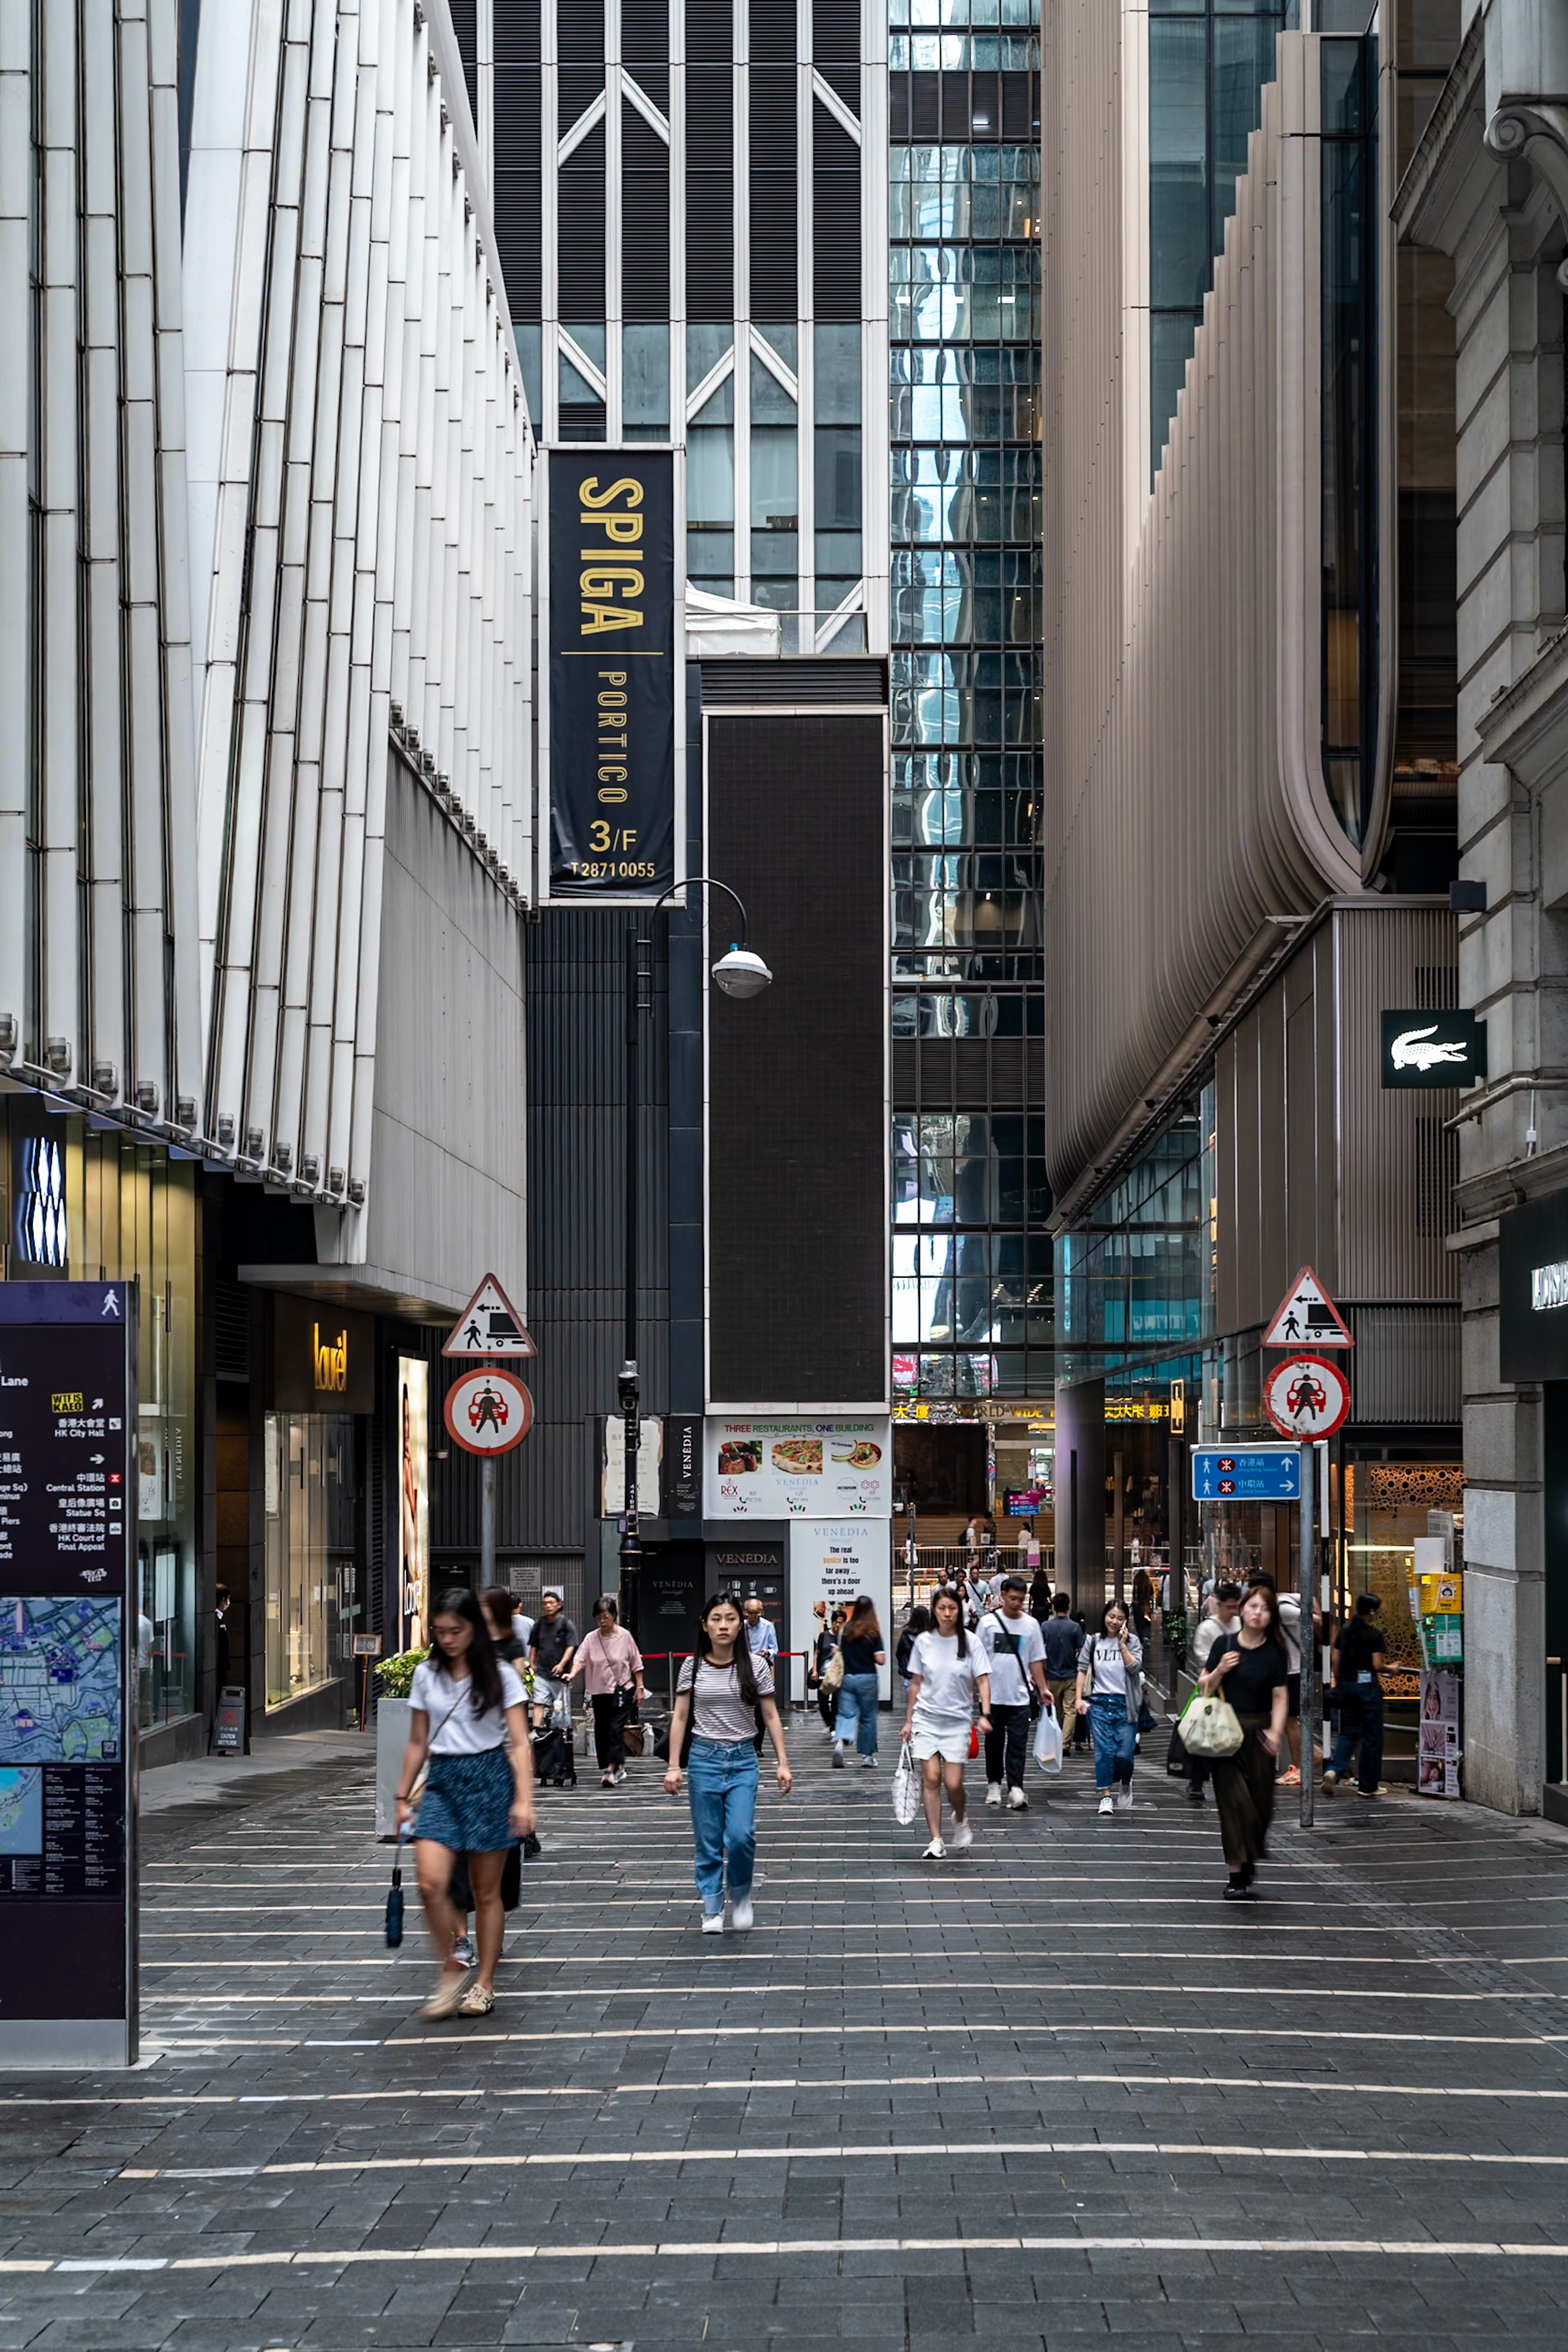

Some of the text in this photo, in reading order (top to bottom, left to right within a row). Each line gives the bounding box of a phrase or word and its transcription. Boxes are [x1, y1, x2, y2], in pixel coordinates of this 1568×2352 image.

[579, 476, 644, 635] SPIGA
[597, 671, 627, 803] PORTICO
[589, 819, 637, 853] 3/F
[1, 1375, 29, 1386] Lane
[58, 1418, 105, 1428] 香港大會堂
[69, 1429, 86, 1438] City
[724, 1424, 874, 1433] THREE RESTAURANTS, ONE BUILDING
[76, 1473, 105, 1483] 中環站
[12, 1482, 28, 1492] Sq)
[46, 1484, 105, 1492] Central Station
[721, 1485, 738, 1496] REX
[58, 1498, 105, 1508] 皇后像廣場
[66, 1509, 105, 1518] Statue Sq
[78, 1543, 105, 1552] Appeal
